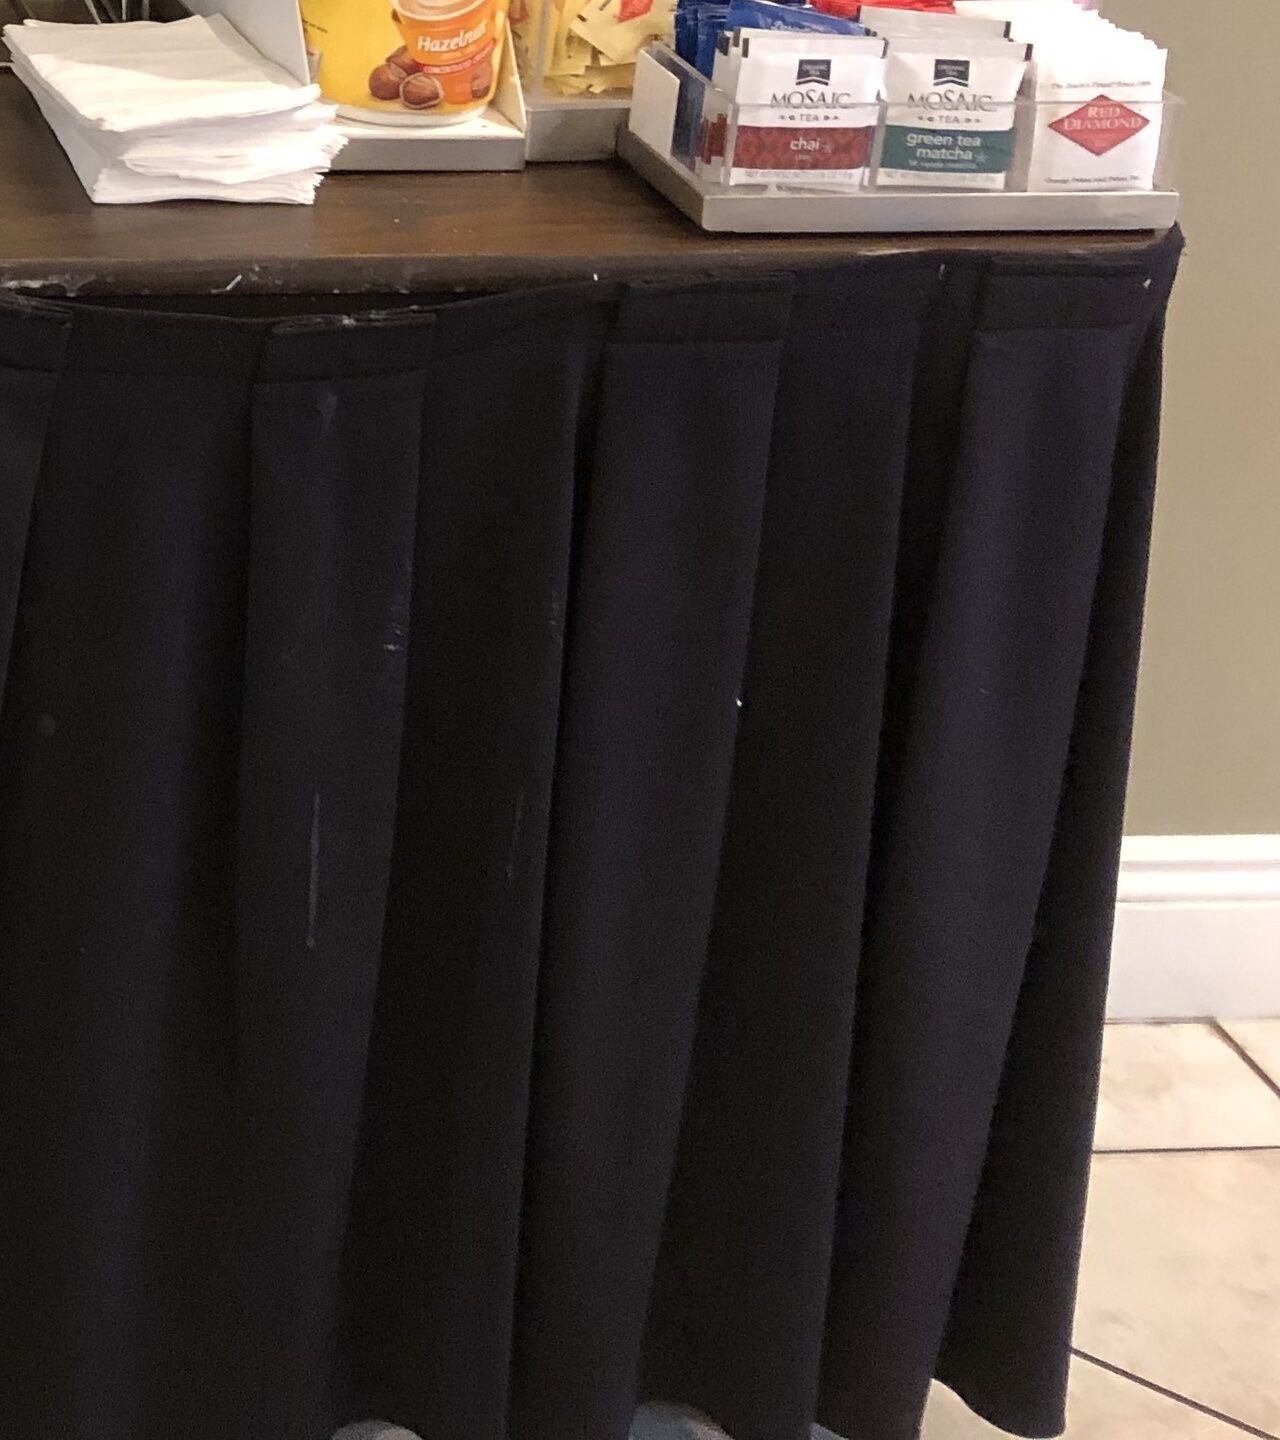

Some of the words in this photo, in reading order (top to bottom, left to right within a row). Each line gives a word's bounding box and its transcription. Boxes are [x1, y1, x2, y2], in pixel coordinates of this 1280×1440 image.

[417, 18, 488, 52] Hazelnut
[770, 88, 852, 110] MOSAIC
[906, 89, 995, 112] MOSAIC
[799, 113, 820, 122] TEA
[1087, 106, 1121, 118] RED
[938, 115, 961, 124] TEA
[1063, 117, 1142, 130] DIAMOND
[789, 137, 820, 151] chai
[906, 133, 953, 147] green
[957, 134, 982, 147] tea
[916, 146, 974, 160] matcha
